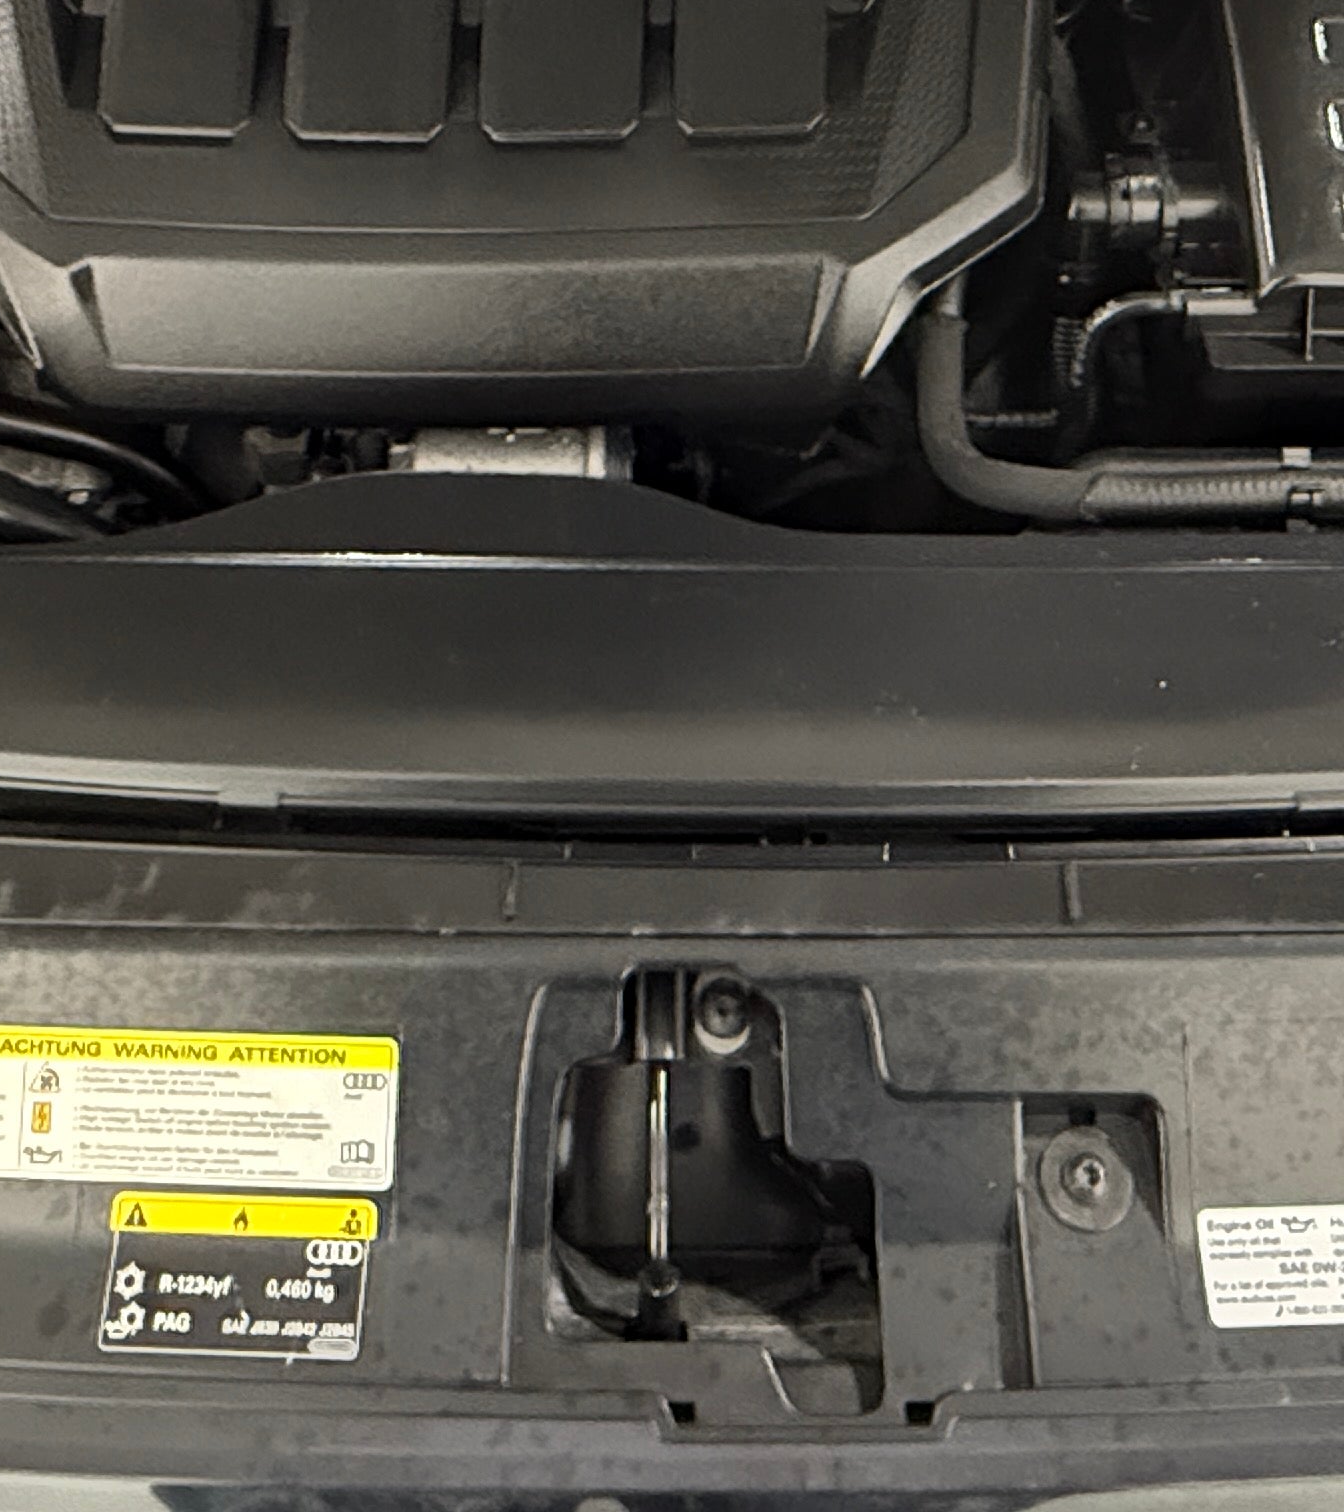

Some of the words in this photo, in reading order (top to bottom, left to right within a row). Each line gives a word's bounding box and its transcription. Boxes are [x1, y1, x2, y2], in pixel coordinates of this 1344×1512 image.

[113, 1042, 218, 1062] WARNING
[229, 1046, 347, 1065] ATTENTION
[158, 1273, 232, 1299] R-1234yf
[314, 1281, 335, 1303] kg
[152, 1312, 192, 1334] PAG
